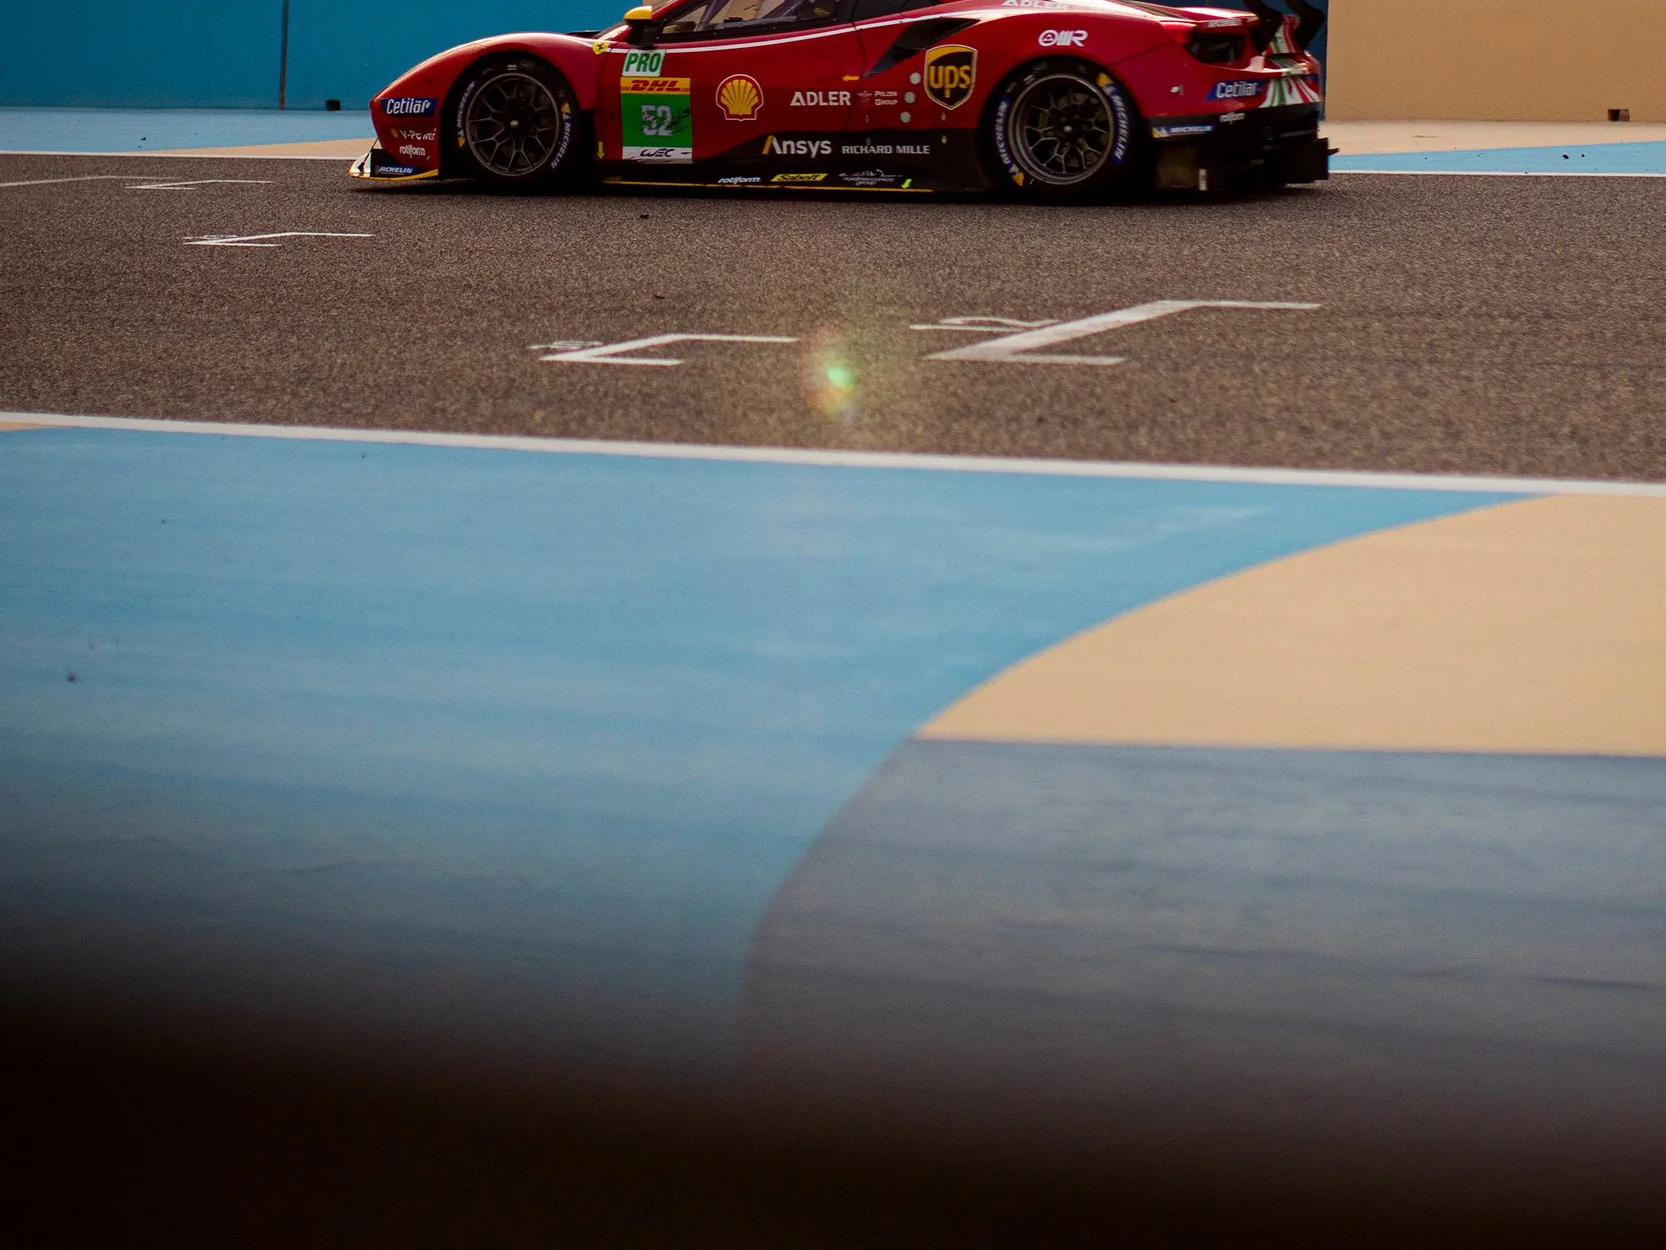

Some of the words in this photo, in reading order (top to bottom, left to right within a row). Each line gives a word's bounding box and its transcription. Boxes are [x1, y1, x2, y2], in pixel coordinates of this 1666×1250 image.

[624, 52, 662, 73] PRO
[630, 79, 681, 92] DHL
[930, 65, 971, 98] ups
[790, 91, 852, 106] ADLER
[640, 104, 673, 137] 52
[1111, 94, 1129, 160] MICHELIN
[995, 101, 1012, 165] MICHELIN
[551, 121, 572, 170] MICHELIN
[639, 148, 675, 158] WEC
[761, 135, 832, 159] Ansys
[842, 145, 893, 155] RICHARD
[896, 145, 931, 155] MILLE
[717, 176, 761, 185] rotiform
